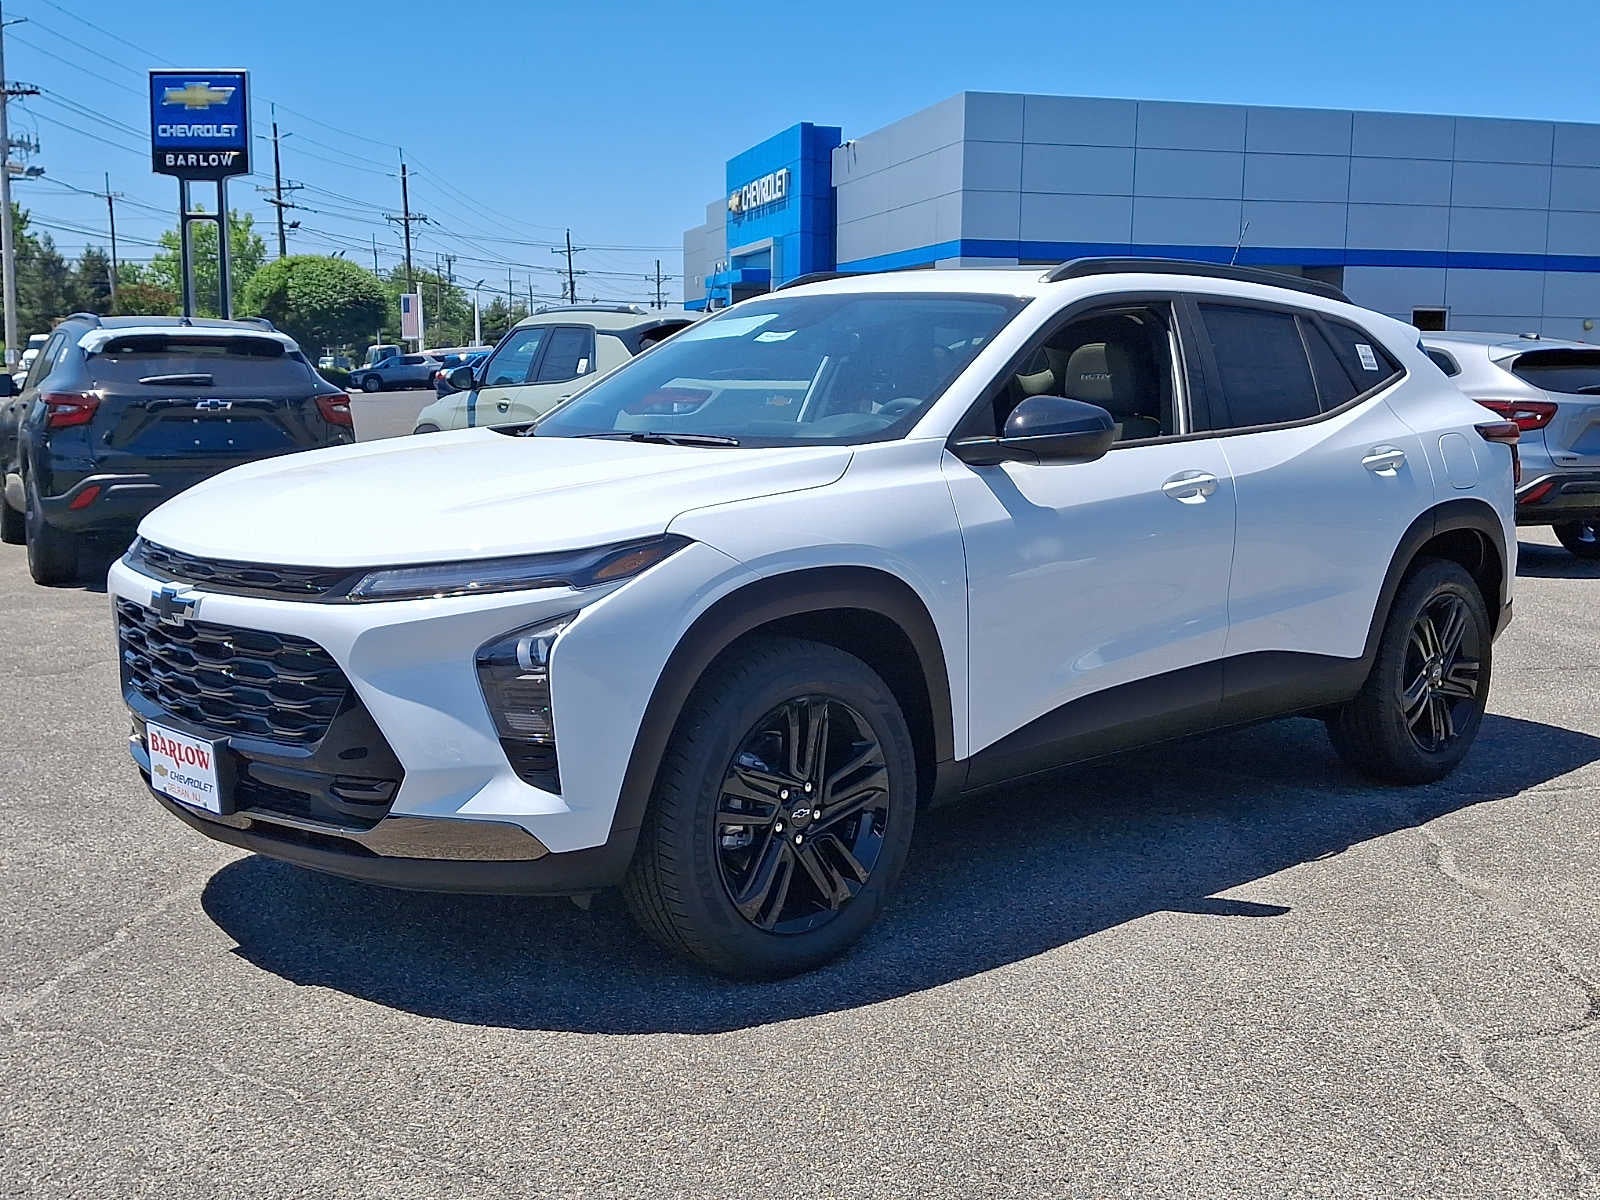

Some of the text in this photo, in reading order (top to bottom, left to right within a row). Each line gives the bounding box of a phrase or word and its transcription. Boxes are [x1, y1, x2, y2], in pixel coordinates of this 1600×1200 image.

[158, 124, 238, 137] CHEVROLET
[165, 154, 233, 167] BARLOW
[742, 168, 788, 211] CHEVROLET
[150, 733, 209, 769] BARLOW
[170, 771, 213, 793] CHEVROLET
